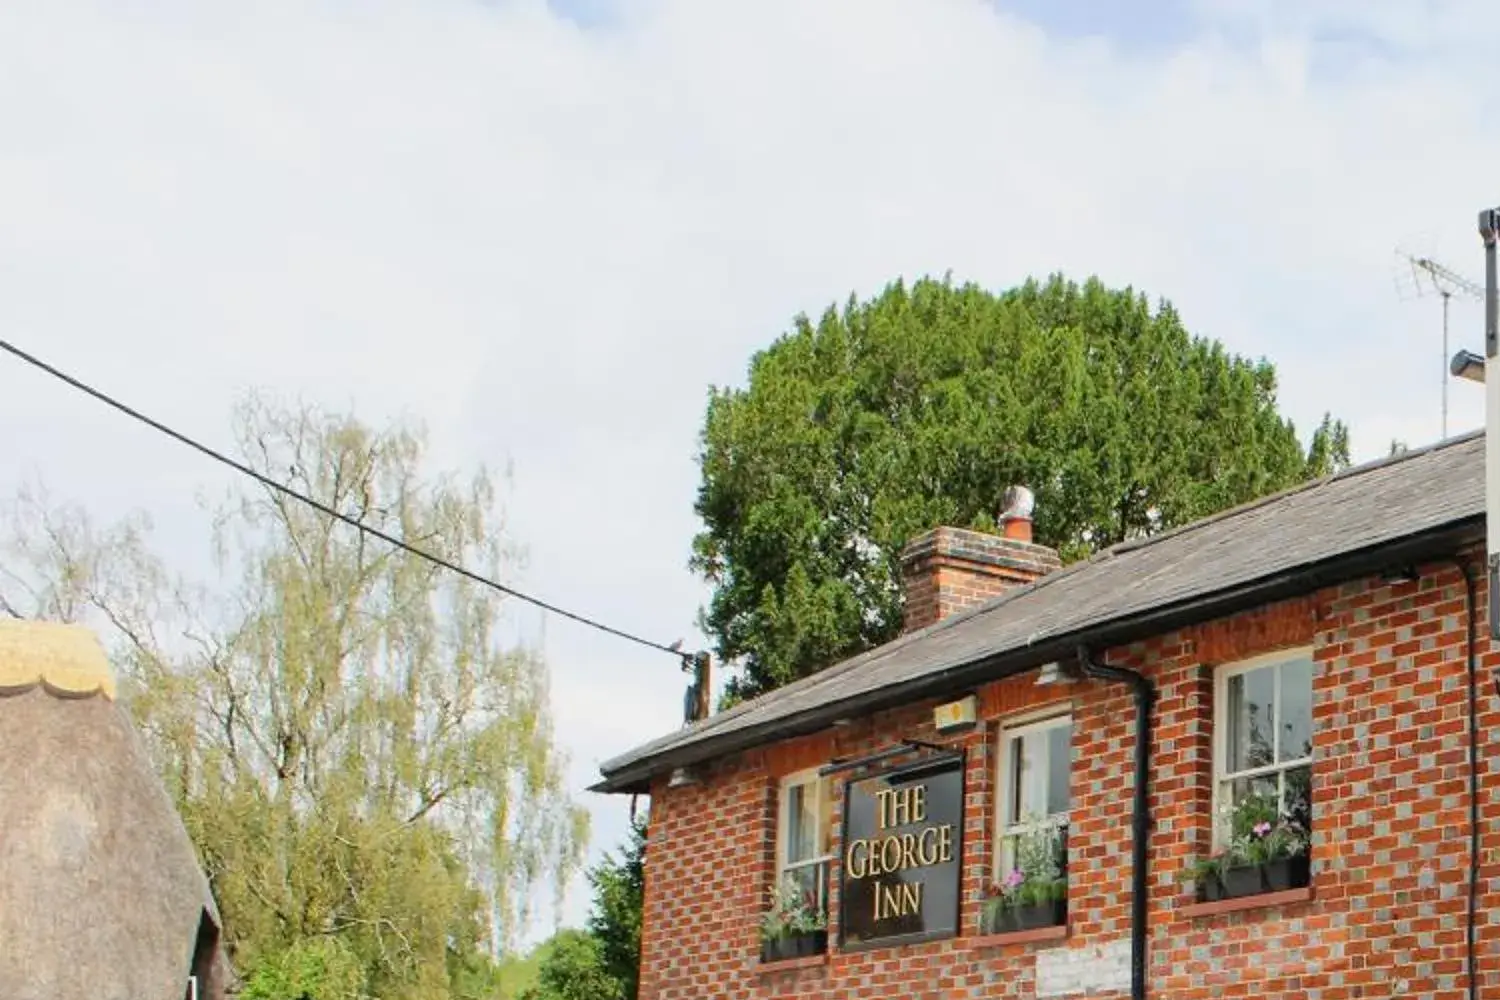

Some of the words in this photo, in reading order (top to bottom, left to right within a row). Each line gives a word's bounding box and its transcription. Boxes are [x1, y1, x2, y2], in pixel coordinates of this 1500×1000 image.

[876, 785, 928, 829] THE
[847, 824, 953, 880] GEORGE
[873, 881, 922, 921] INN
